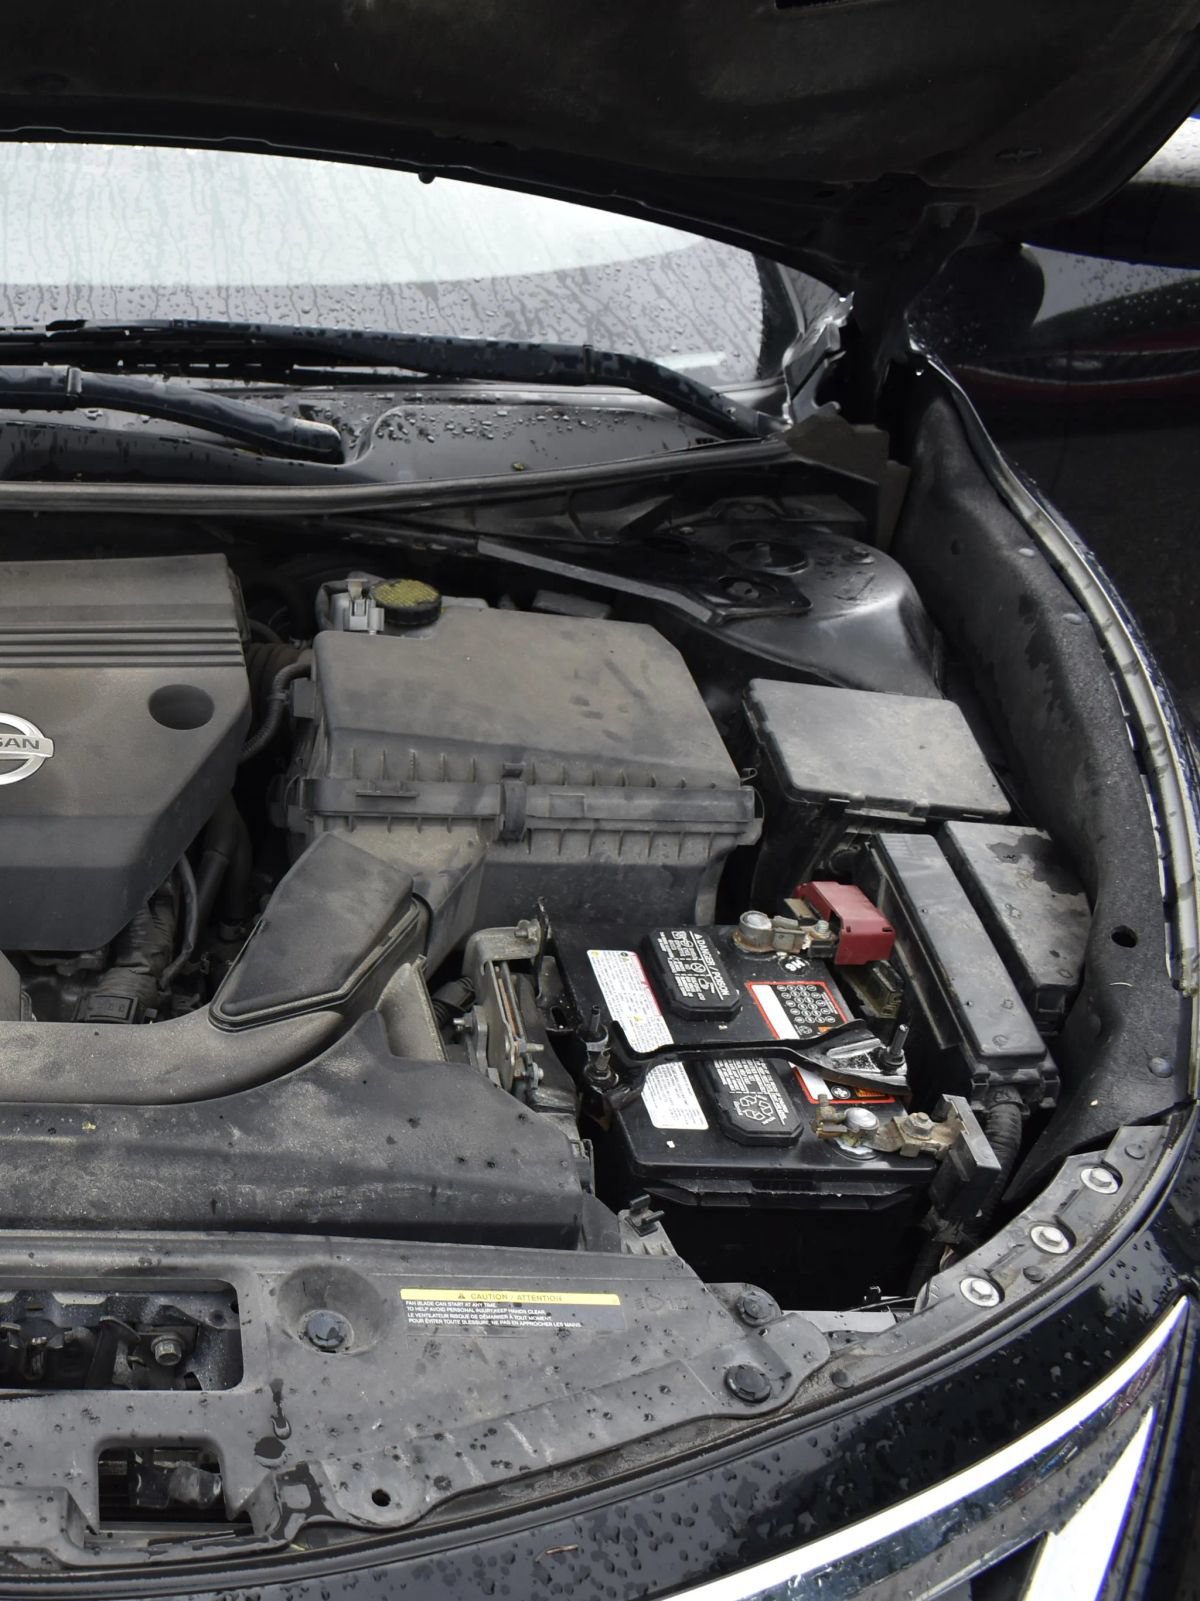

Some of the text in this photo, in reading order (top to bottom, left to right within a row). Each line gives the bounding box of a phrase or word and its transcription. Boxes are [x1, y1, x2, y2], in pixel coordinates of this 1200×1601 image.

[698, 940, 716, 966] DANGER
[712, 972, 730, 996] POISON
[470, 1292, 508, 1301] CAUTION
[516, 1294, 562, 1303] ATTENTION
